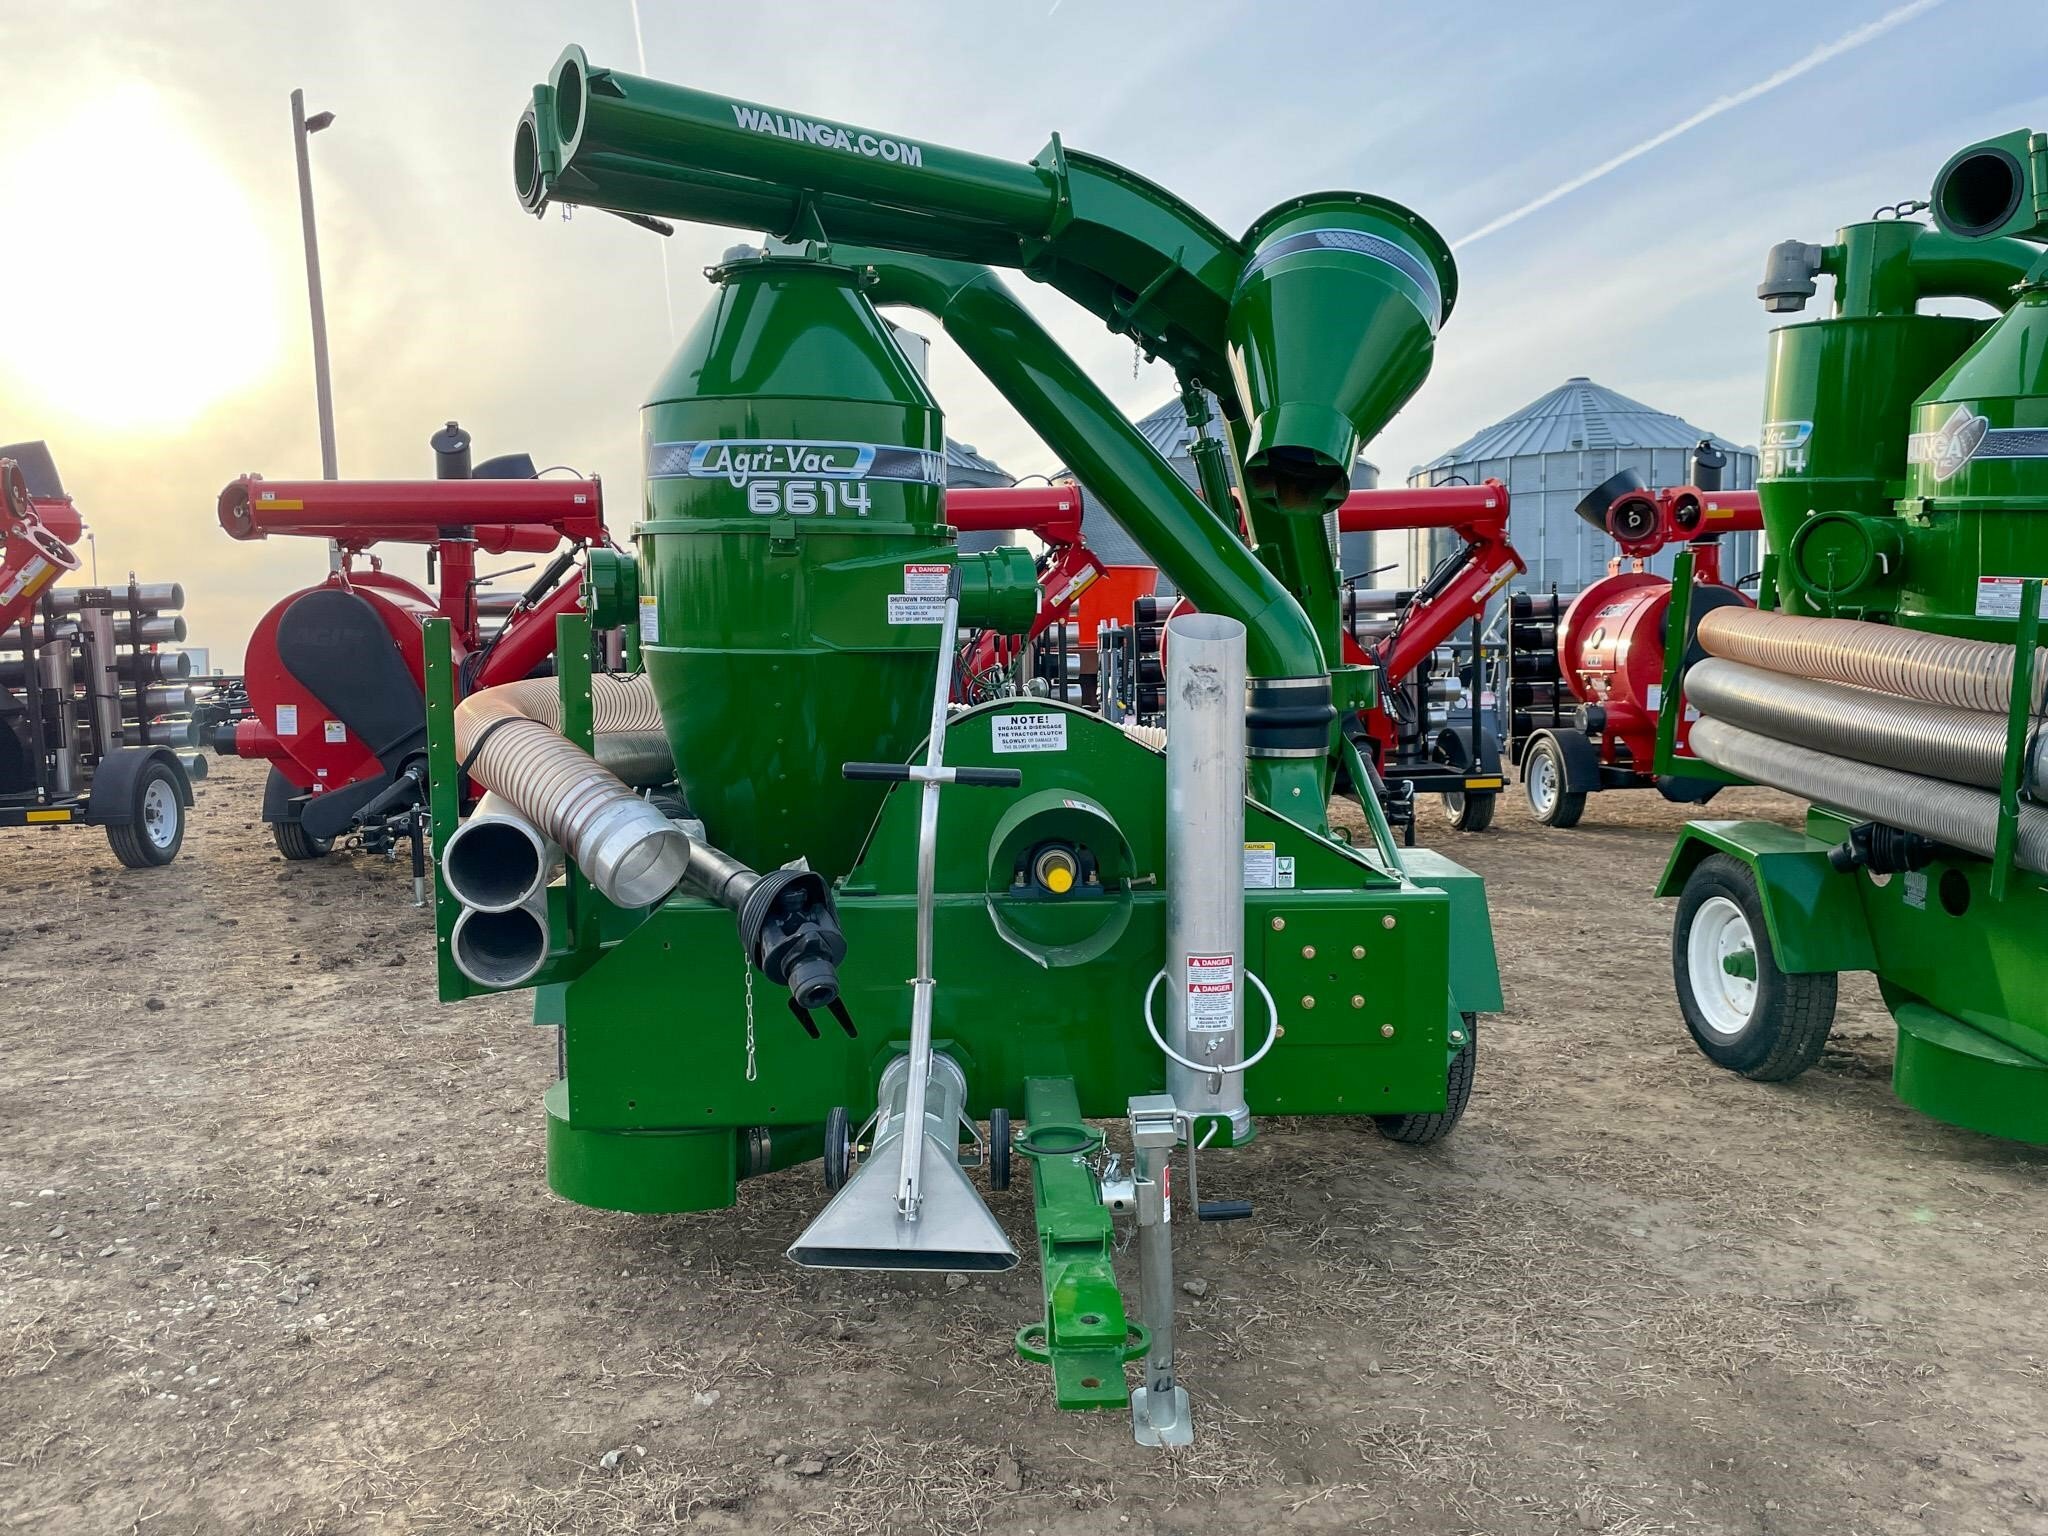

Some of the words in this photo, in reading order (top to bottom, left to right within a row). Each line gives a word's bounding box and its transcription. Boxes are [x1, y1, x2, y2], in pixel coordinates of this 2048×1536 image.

[714, 445, 836, 488] Agri-Vac
[747, 480, 872, 517] 6614
[1010, 716, 1049, 725] NOTE!
[1202, 958, 1230, 967] DANGER
[1202, 984, 1230, 993] DANGER
